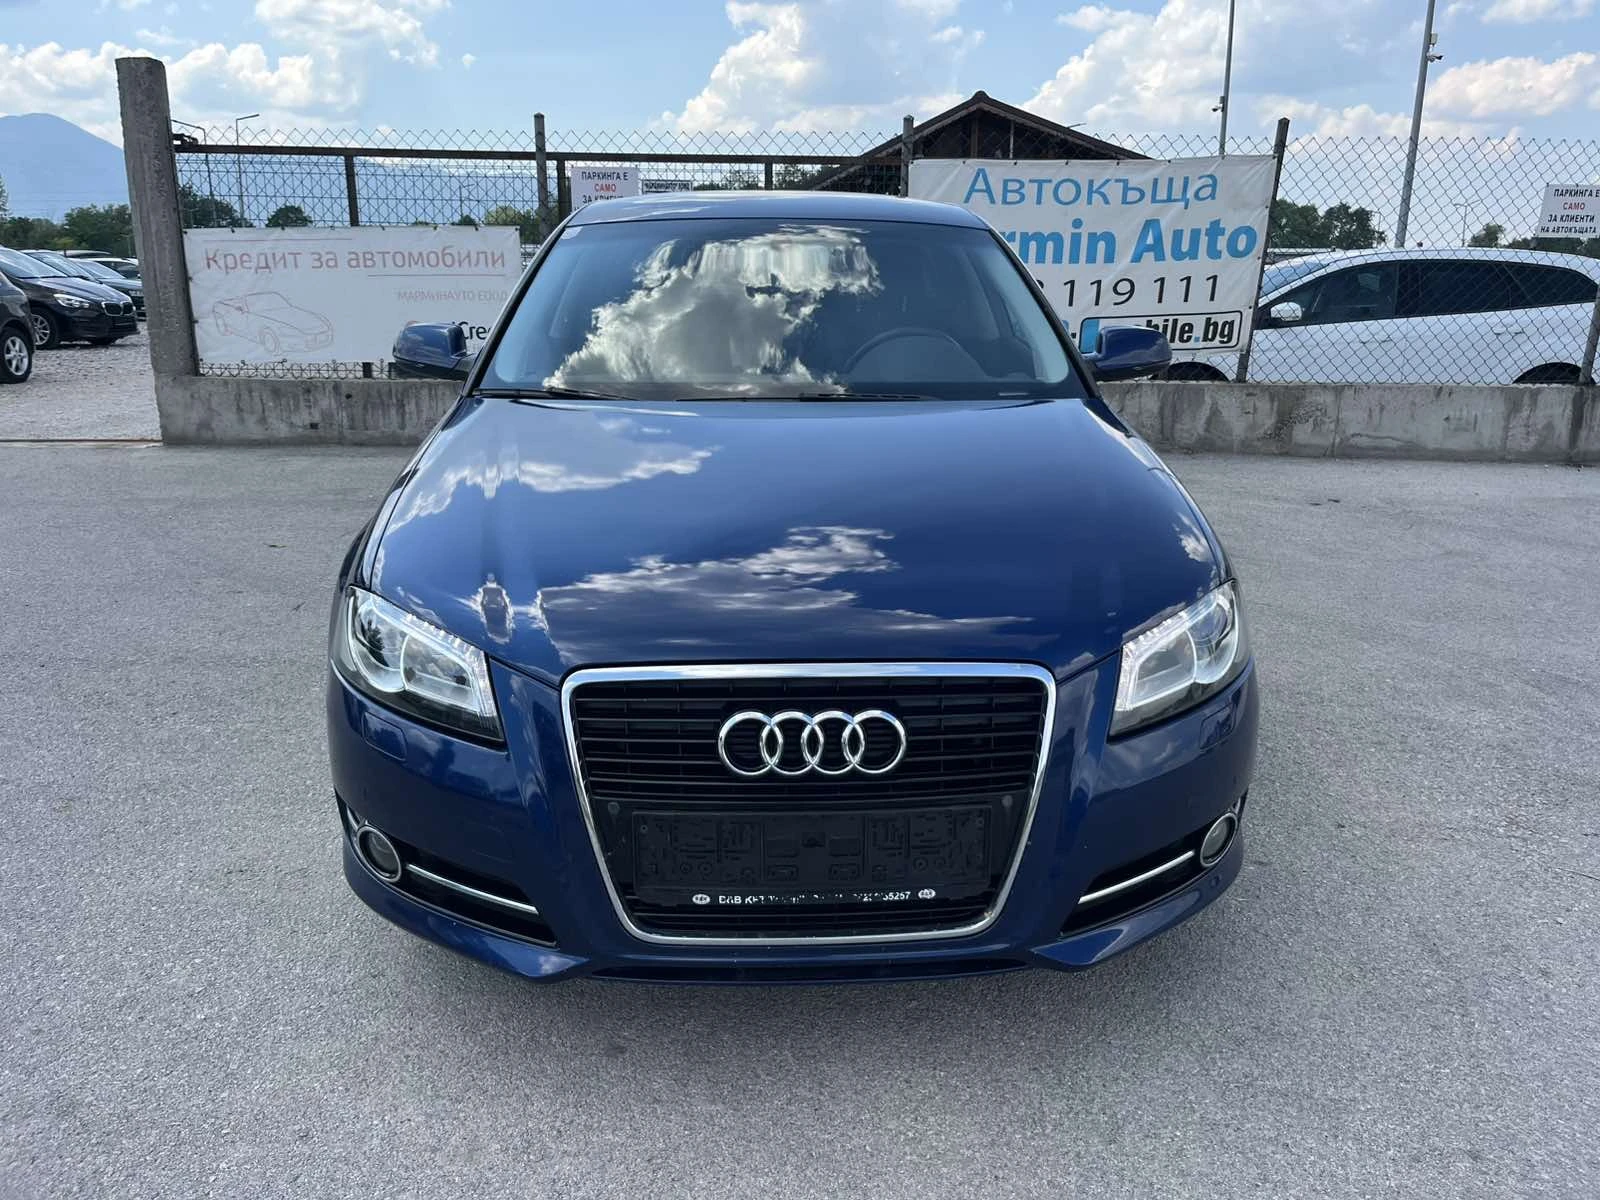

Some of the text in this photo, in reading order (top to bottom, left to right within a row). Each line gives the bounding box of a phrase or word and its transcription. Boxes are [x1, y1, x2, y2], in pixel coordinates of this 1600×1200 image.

[581, 171, 628, 180] ПАРКИНГА Е
[594, 183, 617, 192] САМО
[963, 167, 1218, 210] Автокъща
[1553, 188, 1593, 198] ПАРКИНГА
[1562, 202, 1586, 210] САМО
[1559, 214, 1595, 223] КЛИЕНТИ
[1540, 225, 1597, 234] НА АВТОКЪЩАТА
[1130, 218, 1257, 263] Auto
[205, 245, 505, 274] Кредит за автомобили
[1063, 274, 1218, 307] 119 111
